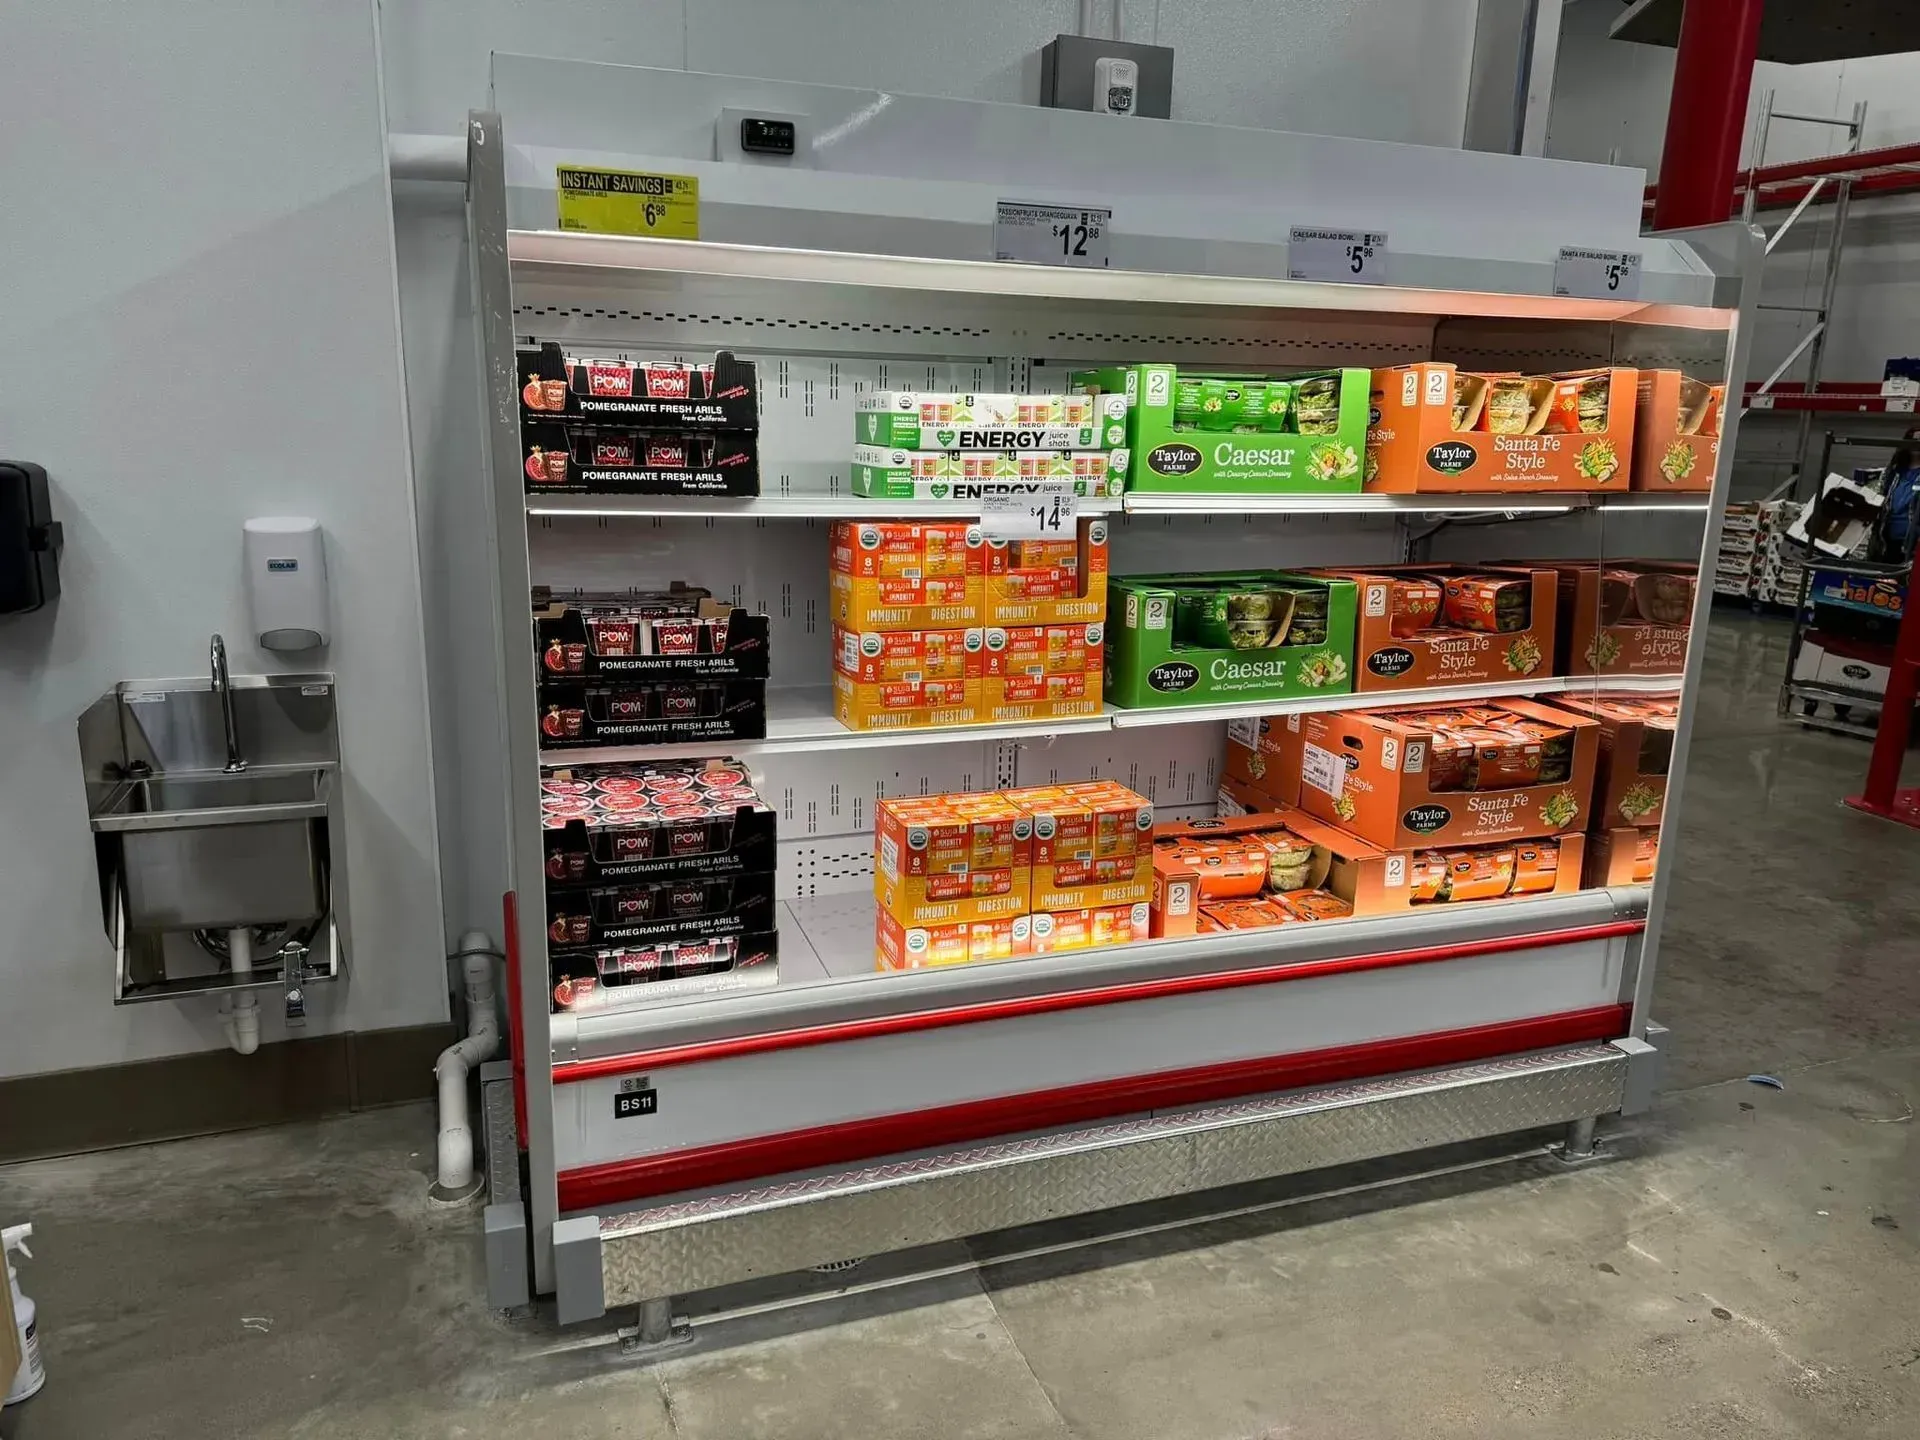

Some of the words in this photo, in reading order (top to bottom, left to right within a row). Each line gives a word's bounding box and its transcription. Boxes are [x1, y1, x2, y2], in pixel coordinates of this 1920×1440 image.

[562, 172, 610, 191] INSTANT
[613, 176, 661, 194] SAVINGS
[1293, 231, 1317, 239] CAESAR
[594, 375, 627, 390] POM
[653, 378, 685, 391] POM
[1151, 375, 1164, 394] 2
[1406, 376, 1414, 394] 2
[1431, 375, 1442, 393] 2
[580, 402, 657, 413] POMEGRANATE
[660, 403, 692, 415] FRESH
[694, 404, 725, 416] ARILS
[682, 413, 697, 421] from
[699, 413, 728, 423] California
[960, 431, 1046, 448] ENERGY
[1048, 438, 1070, 447] shots
[1050, 432, 1069, 443] juice
[1377, 429, 1396, 442] Style
[597, 444, 629, 459] POM
[1494, 436, 1540, 452] Santa
[1543, 437, 1561, 452] Fe
[651, 446, 682, 460] POM
[1155, 449, 1197, 463] Taylor
[1214, 443, 1295, 466] Caesar
[1433, 447, 1471, 462] Taylor
[1505, 454, 1545, 470] Style
[582, 471, 658, 482] POMEGRANATE
[661, 472, 692, 482] FRESH
[695, 473, 724, 483] ARILS
[682, 481, 697, 489] from
[698, 481, 728, 490] California
[1043, 484, 1062, 493] juice
[1370, 589, 1382, 606] 2
[1843, 580, 1902, 610] halos
[867, 609, 912, 622] IMMUNITY
[932, 606, 976, 620] DIGESTION
[995, 605, 1038, 619] IMMUNITY
[1056, 602, 1098, 616] DIGESTION
[1150, 602, 1162, 618] 2
[600, 630, 629, 643] POM
[664, 633, 692, 646] POM
[1430, 638, 1472, 654] Santa
[1473, 637, 1490, 651] Fe
[600, 658, 672, 670] POMEGRANATE
[675, 656, 705, 668] FRESH
[708, 655, 735, 666] ARILS
[1374, 652, 1410, 666] Taylor
[1441, 653, 1476, 670] Style
[1155, 667, 1194, 684] Taylor
[1210, 659, 1287, 681] Caesar
[611, 700, 641, 713] POM
[667, 696, 696, 709] POM
[992, 704, 1035, 719] IMMUNITY
[1052, 701, 1095, 715] DIGESTION
[868, 712, 912, 727] IMMUNITY
[931, 708, 975, 723] DIGESTION
[597, 722, 669, 735] POMEGRANATE
[672, 719, 702, 731] FRESH
[705, 717, 731, 728] ARILS
[1384, 741, 1395, 759] 2
[1407, 746, 1421, 763] 2
[1354, 776, 1375, 793] Style
[1468, 796, 1511, 812] Santa
[1512, 794, 1529, 808] Fe
[1410, 809, 1447, 824] Taylor
[1477, 810, 1515, 827] Style
[617, 835, 648, 849] POM
[674, 830, 705, 844] POM
[602, 863, 675, 875] POMEGRANATE
[679, 857, 709, 869] FRESH
[712, 854, 740, 866] ARILS
[1388, 859, 1402, 877] 2
[673, 892, 703, 906] POM
[1042, 892, 1085, 907] IMMUNITY
[1103, 885, 1146, 901] DIGESTION
[1173, 886, 1186, 904] 2
[618, 899, 649, 913] POM
[914, 904, 959, 920] IMMUNITY
[978, 896, 1022, 912] DIGESTION
[604, 925, 676, 938] POMEGRANATE
[680, 920, 709, 932] FRESH
[713, 915, 740, 928] ARILS
[624, 958, 655, 973] POM
[680, 952, 710, 967] POM
